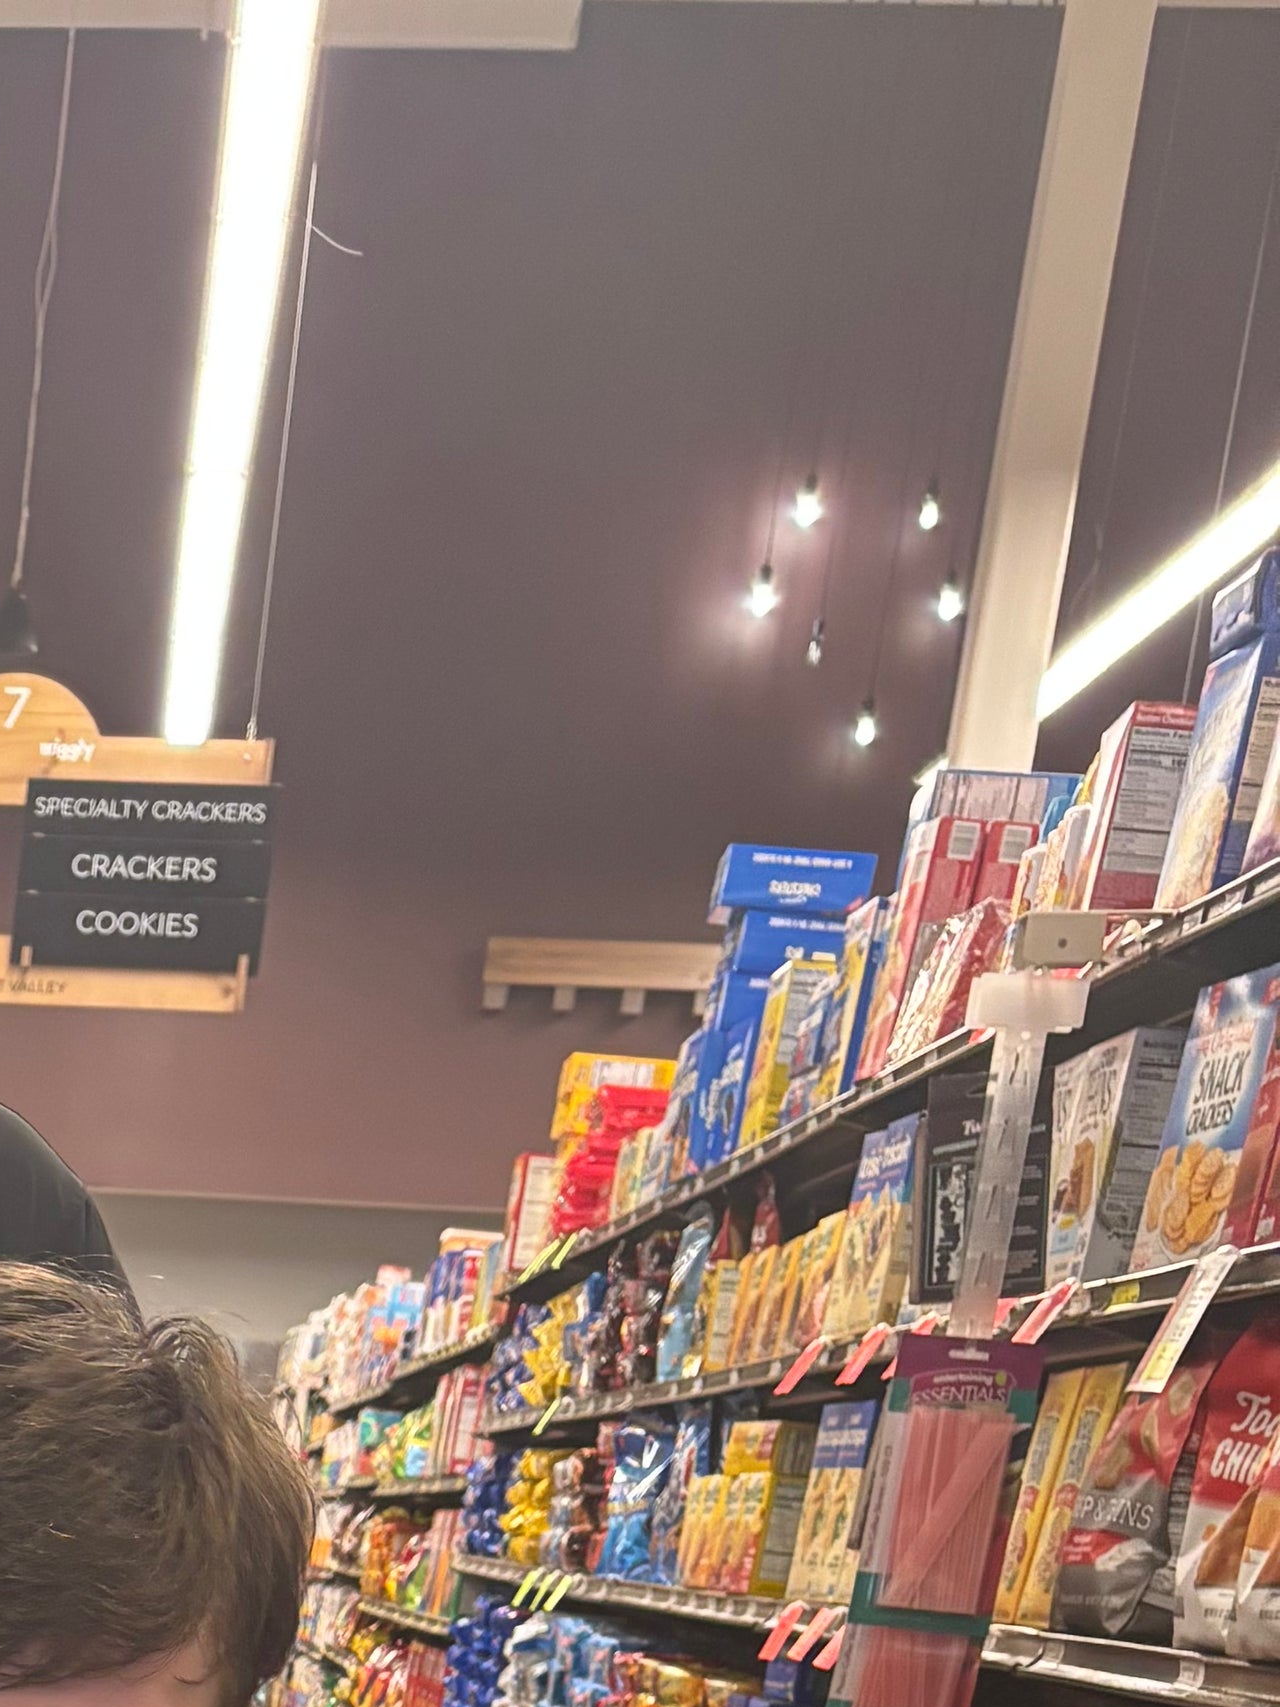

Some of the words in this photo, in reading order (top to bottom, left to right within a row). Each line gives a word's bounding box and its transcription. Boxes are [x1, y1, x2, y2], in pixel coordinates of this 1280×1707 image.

[2, 685, 32, 730] 7
[39, 738, 96, 763] wiggly
[34, 796, 149, 820] SPECIALTY
[151, 799, 268, 825] CRACKERS
[71, 853, 217, 883] CRACKERS
[75, 909, 199, 939] COOKIES
[1194, 1050, 1251, 1106] SNACK
[1186, 1098, 1238, 1136] CRACKERS
[912, 1386, 1006, 1402] ESSENTIALS
